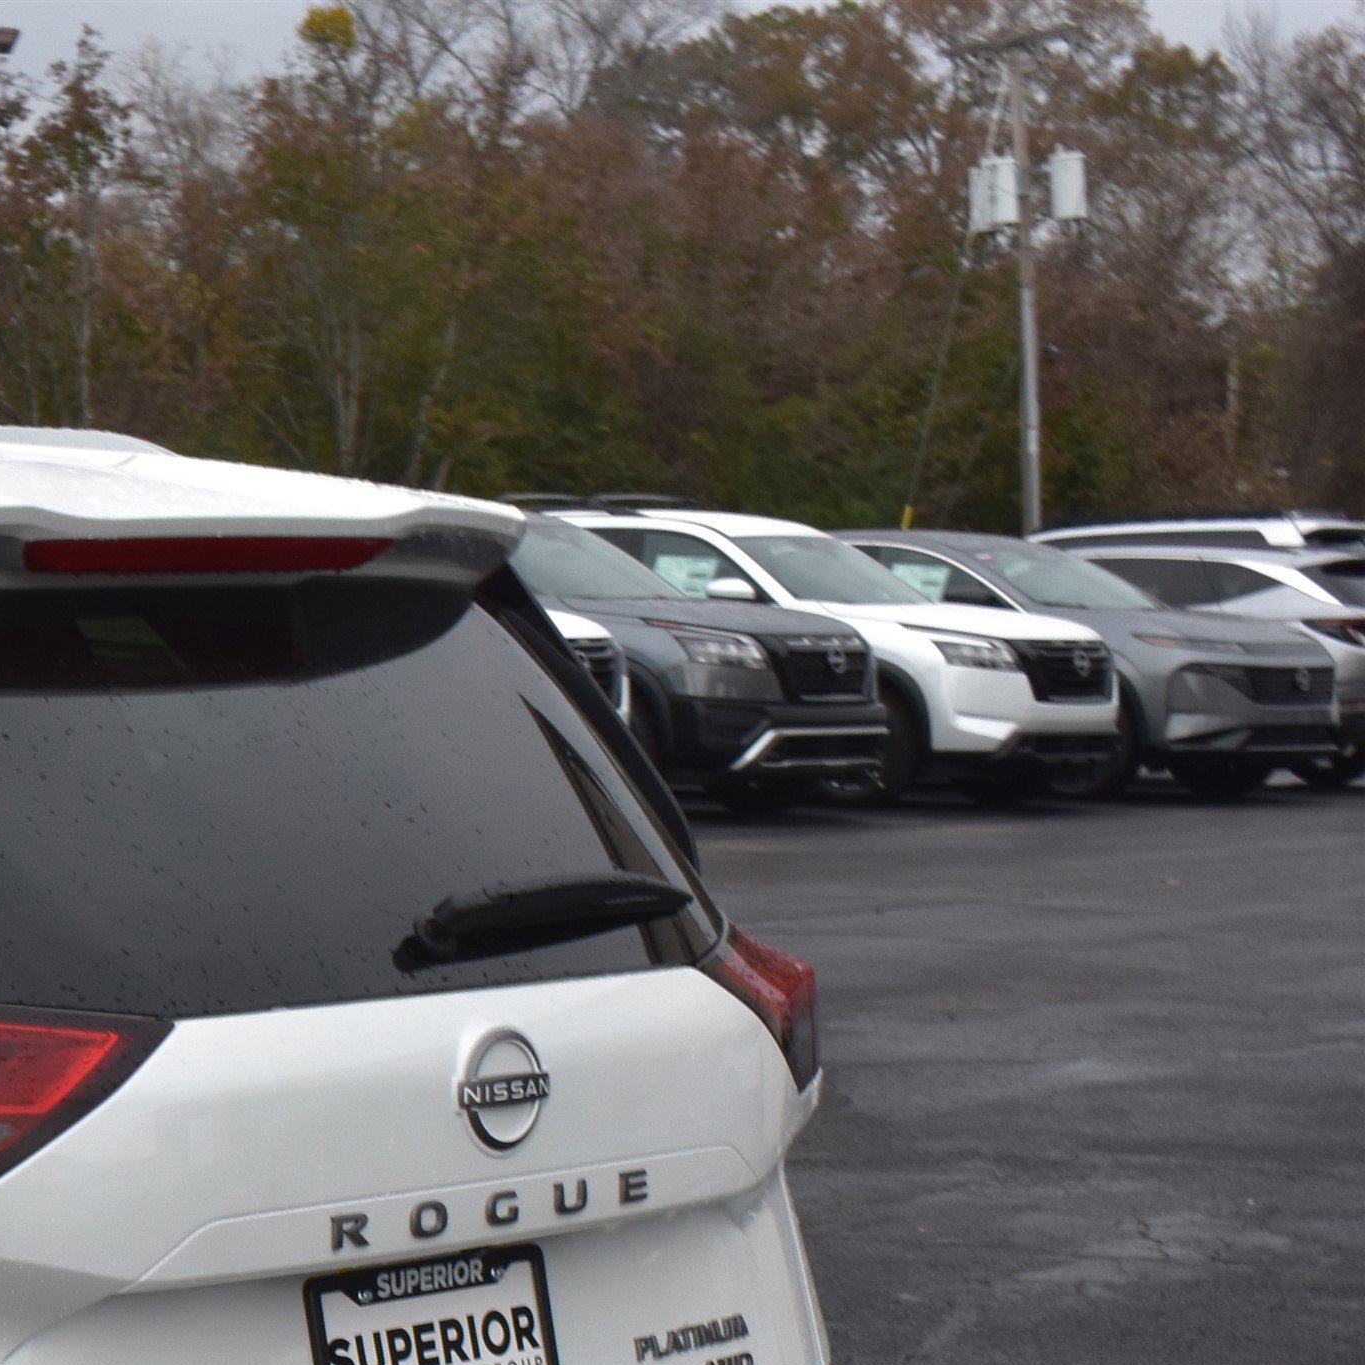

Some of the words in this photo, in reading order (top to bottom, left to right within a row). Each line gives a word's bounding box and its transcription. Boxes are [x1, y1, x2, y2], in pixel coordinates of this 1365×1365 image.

[463, 1077, 549, 1105] NISSAN
[330, 1168, 649, 1254] ROGUE
[376, 1258, 485, 1299] SUPERIOR
[633, 1312, 749, 1363] PLATINUM
